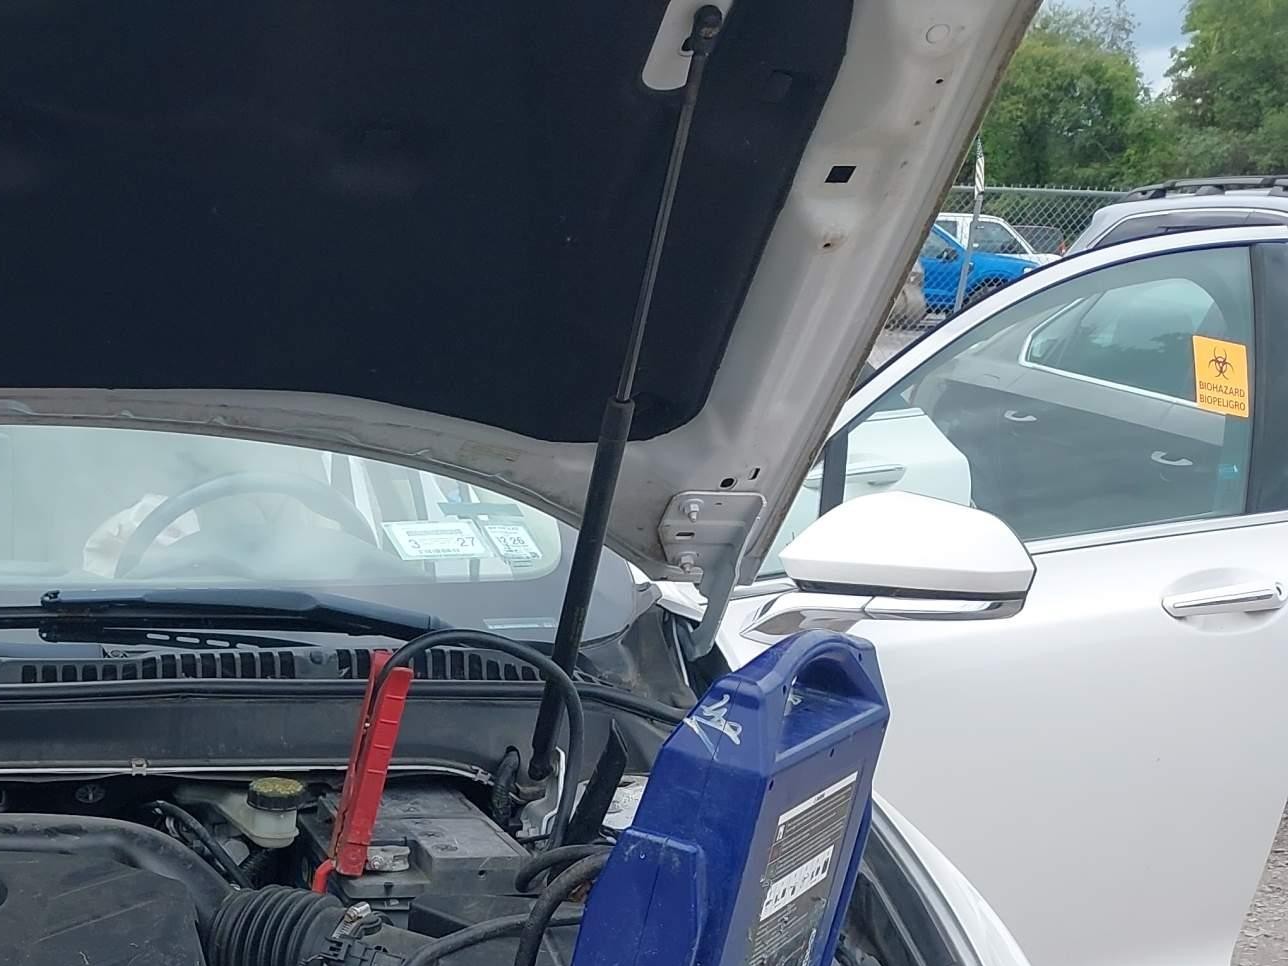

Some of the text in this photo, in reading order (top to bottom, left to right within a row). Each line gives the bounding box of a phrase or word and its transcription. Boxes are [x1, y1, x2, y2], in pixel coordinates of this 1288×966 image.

[1199, 380, 1246, 398] BIOHAZARD
[1199, 394, 1246, 411] BIOPELIGRO
[456, 536, 475, 547] 27
